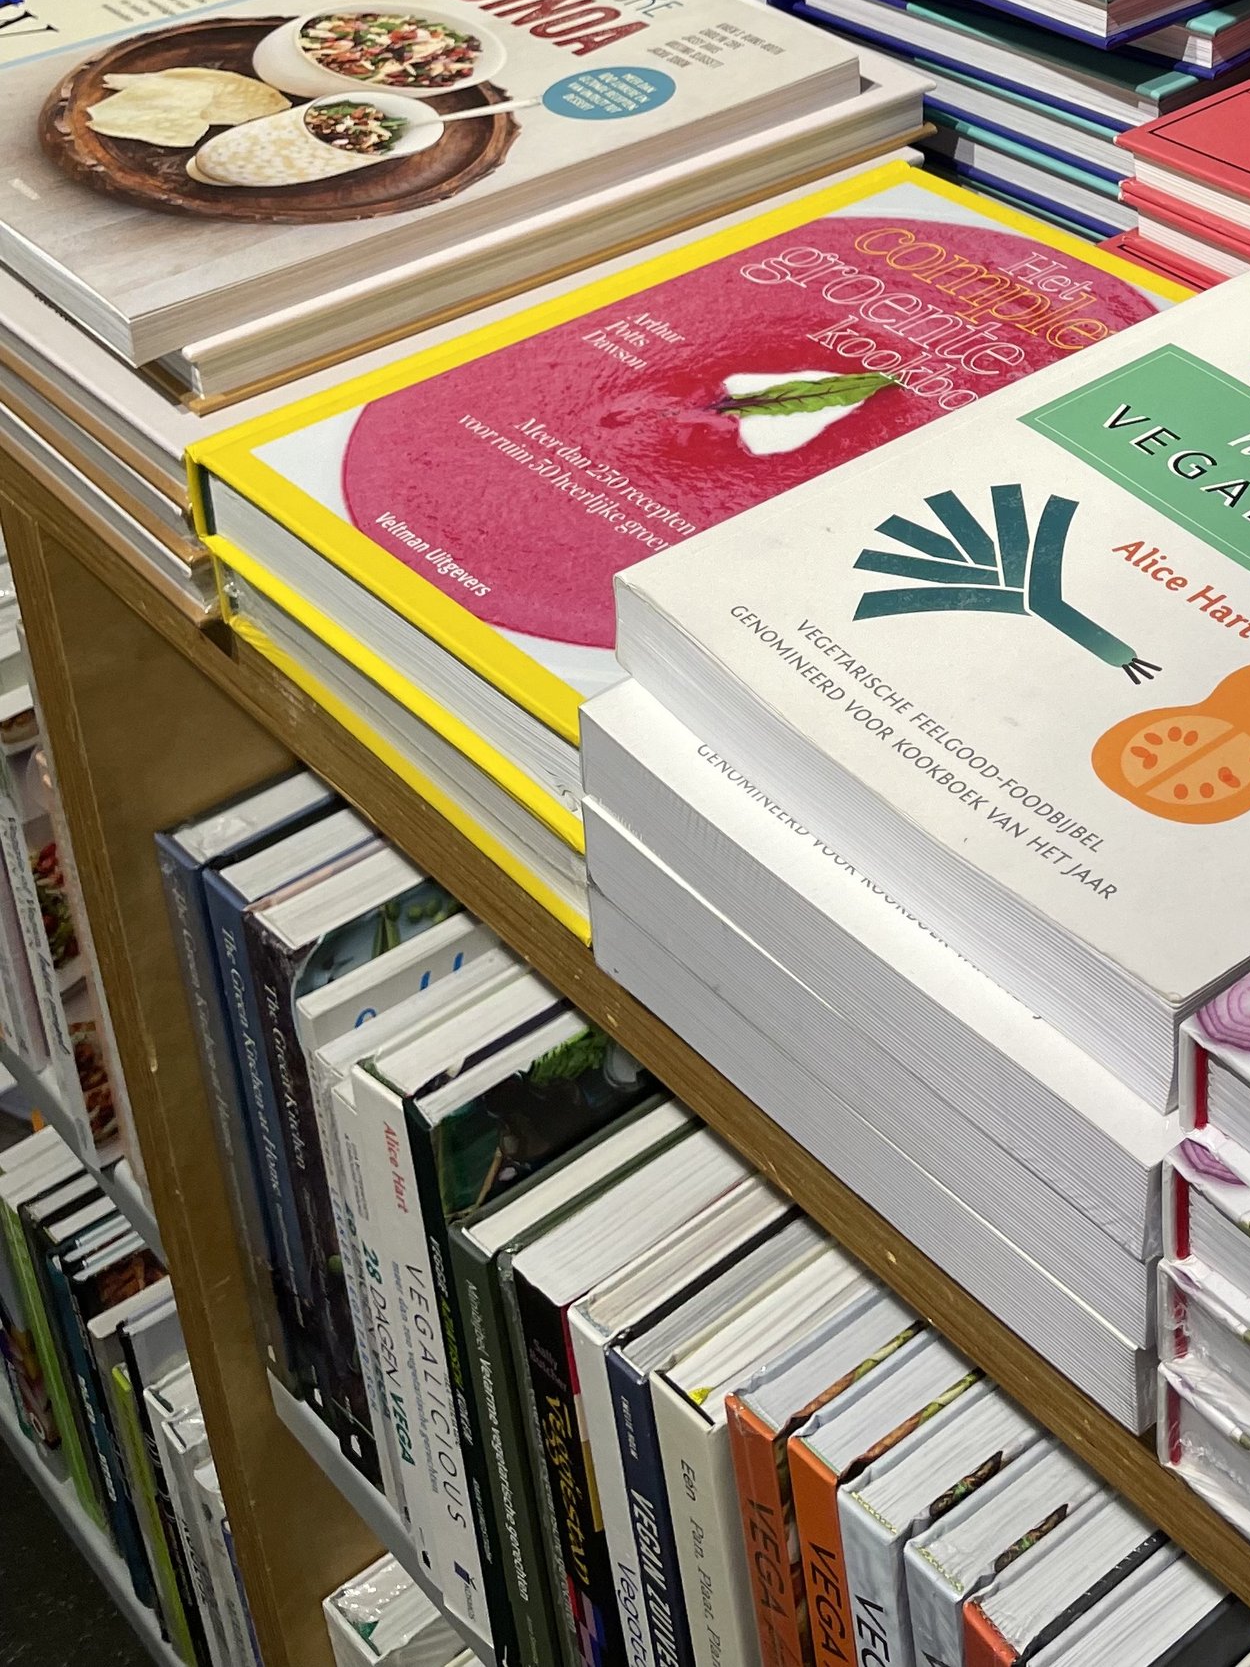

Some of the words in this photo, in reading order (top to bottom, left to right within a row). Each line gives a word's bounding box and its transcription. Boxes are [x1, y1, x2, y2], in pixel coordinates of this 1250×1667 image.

[628, 312, 686, 345] Arthur
[739, 245, 1026, 376] groente
[853, 226, 1118, 351] comple
[999, 251, 1094, 301] Het
[581, 329, 648, 372] Dawson
[603, 319, 651, 348] Potts
[806, 314, 979, 412] kookbo
[457, 414, 499, 444] voor
[496, 435, 535, 467] ruim
[528, 456, 558, 485] 50
[550, 469, 627, 530] heerlijke
[514, 417, 563, 456] Meer
[556, 443, 590, 471] dan
[586, 462, 629, 495] 250
[619, 483, 698, 537] recepten
[375, 511, 427, 554] Veltman
[425, 545, 492, 598] Uitgevers
[1111, 540, 1188, 592] Alice
[730, 604, 845, 702] GENOMINEERD
[844, 699, 894, 741] VOOR
[892, 738, 989, 811] KOOKBOEK
[987, 807, 1029, 839] VAN
[1027, 835, 1073, 866] HET
[1060, 862, 1118, 900] JAAR
[797, 618, 914, 715] VEGETARISCHE
[909, 711, 1104, 853] FEELGOOD-FOODBIJBEL
[263, 984, 278, 1018] The
[271, 1020, 294, 1081] Green
[283, 1084, 308, 1172] Kitchen
[362, 1242, 384, 1285] 28
[369, 1286, 403, 1387] DAGEN
[383, 1120, 400, 1172] Alice
[395, 1172, 408, 1214] Hart
[405, 1263, 467, 1530] VEGALICIOUS
[386, 1389, 417, 1467] VEGA
[480, 1357, 499, 1429] Vetarme
[494, 1428, 517, 1526] vegetarische
[506, 1522, 530, 1603] gerechten
[629, 1488, 667, 1567] VEGAN
[746, 1497, 790, 1618] VEGA
[808, 1541, 848, 1661] VEGA
